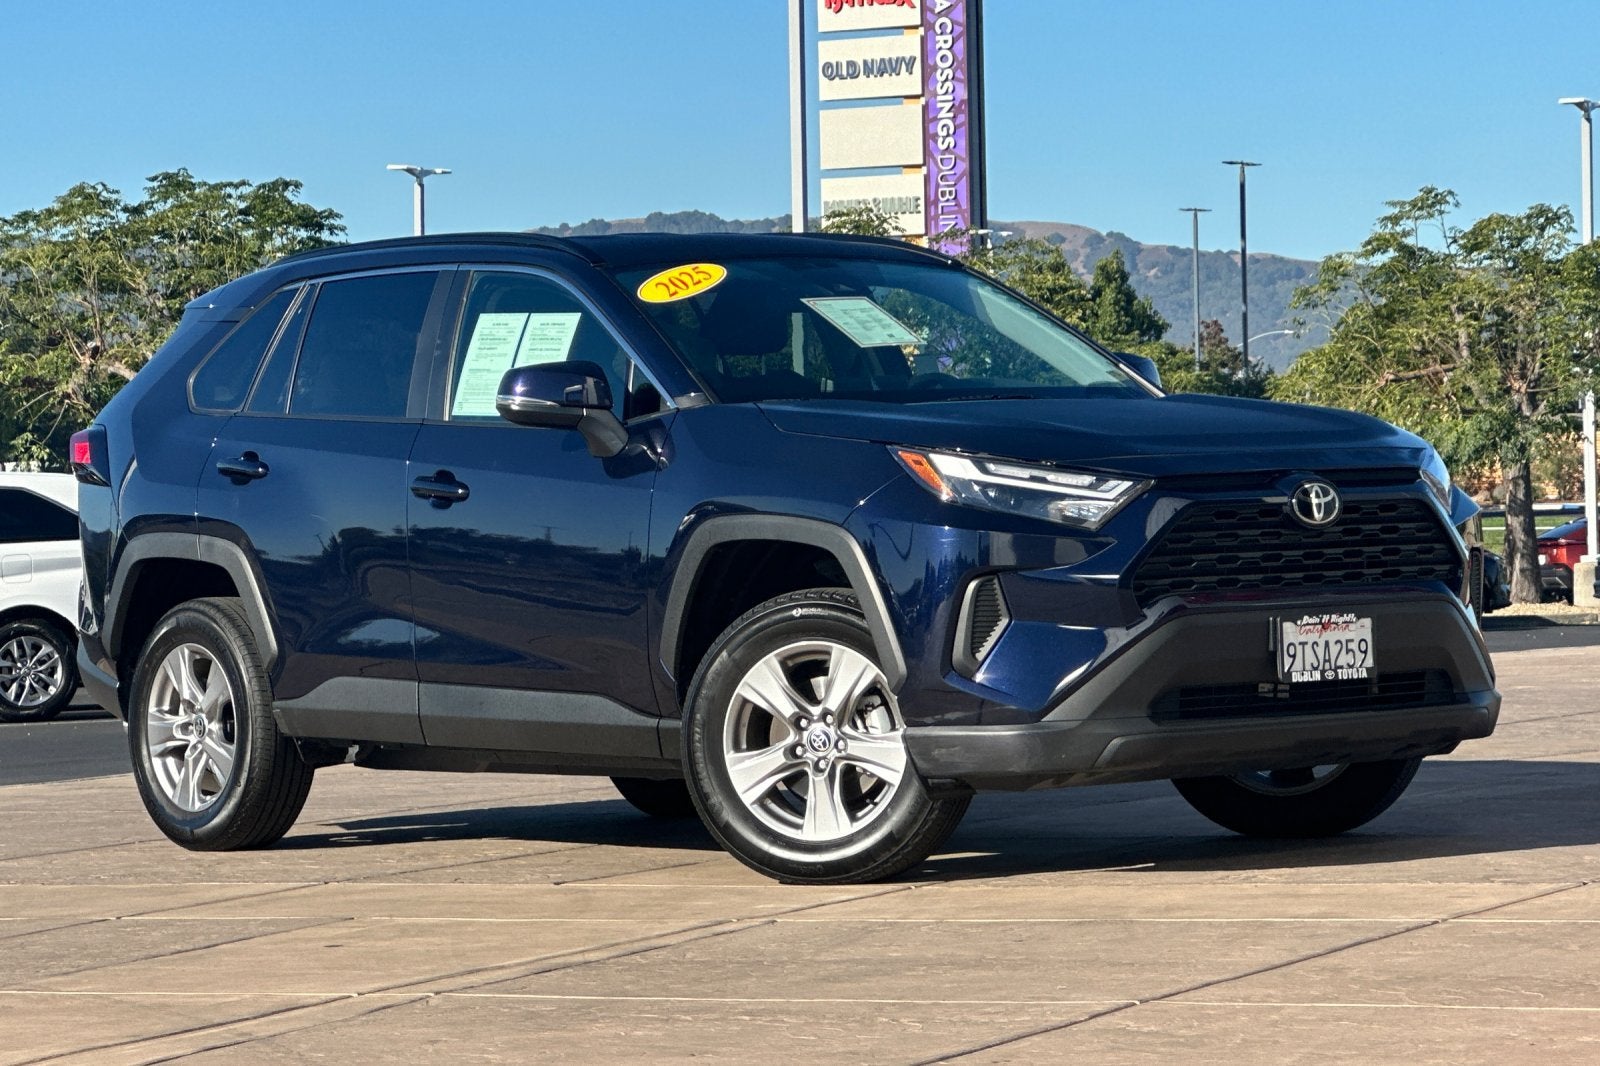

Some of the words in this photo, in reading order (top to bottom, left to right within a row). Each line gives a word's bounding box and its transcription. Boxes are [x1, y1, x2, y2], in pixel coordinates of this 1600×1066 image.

[821, 60, 860, 81] OLD
[862, 55, 917, 78] NAVY
[934, 16, 955, 150] CROSSINGS
[937, 154, 956, 234] DUBLIN
[655, 266, 712, 298] 2025
[1286, 638, 1368, 672] 9TSA259
[1291, 671, 1321, 682] DUBLIN
[1337, 667, 1368, 680] TOYOTA
